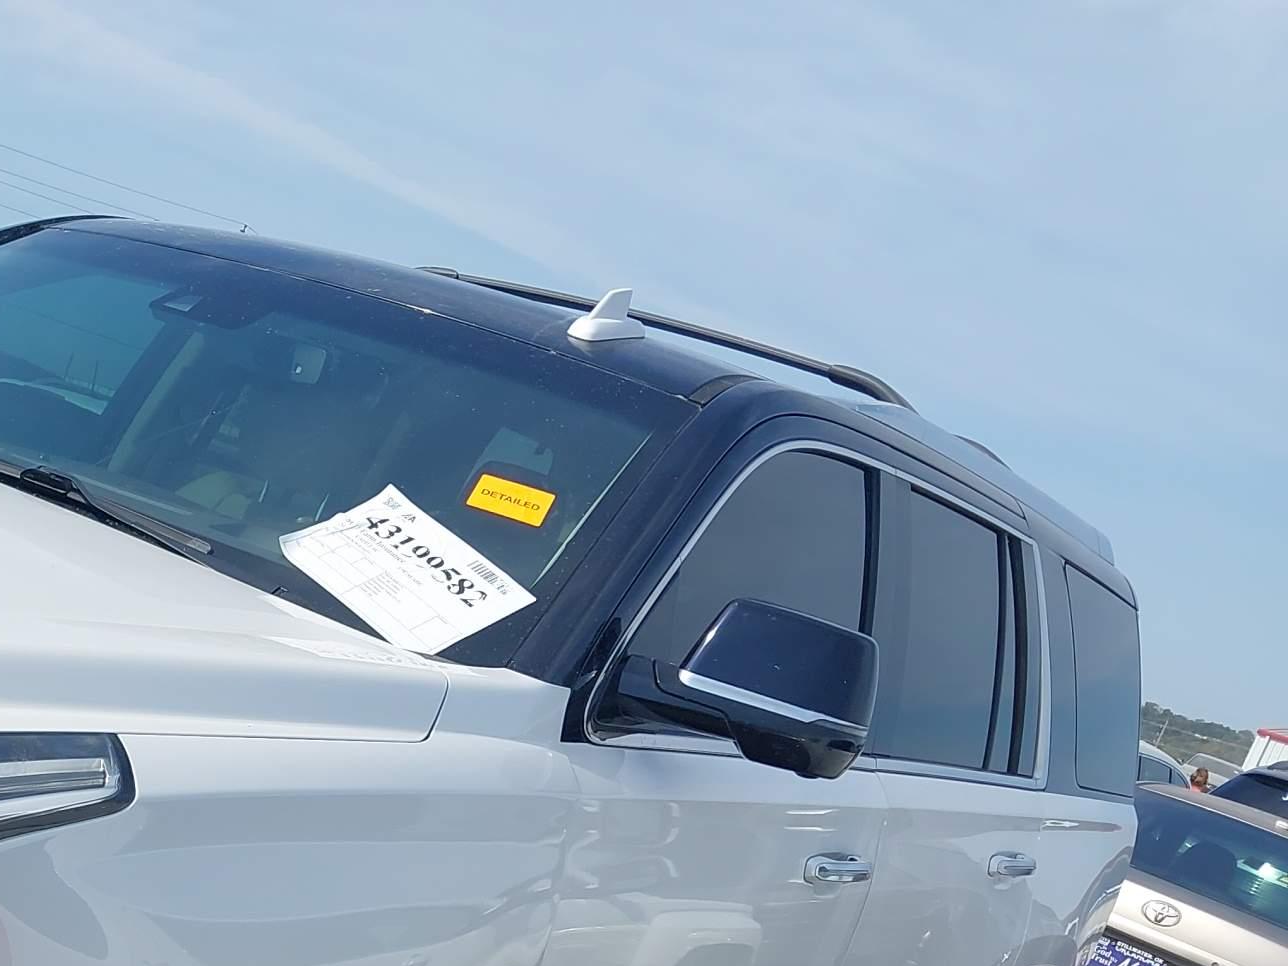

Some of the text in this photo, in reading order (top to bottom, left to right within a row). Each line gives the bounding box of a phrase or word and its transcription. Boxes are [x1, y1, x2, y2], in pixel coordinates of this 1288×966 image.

[480, 488, 541, 511] DETAILED
[1094, 946, 1112, 957] God
[1091, 953, 1112, 966] Trust
